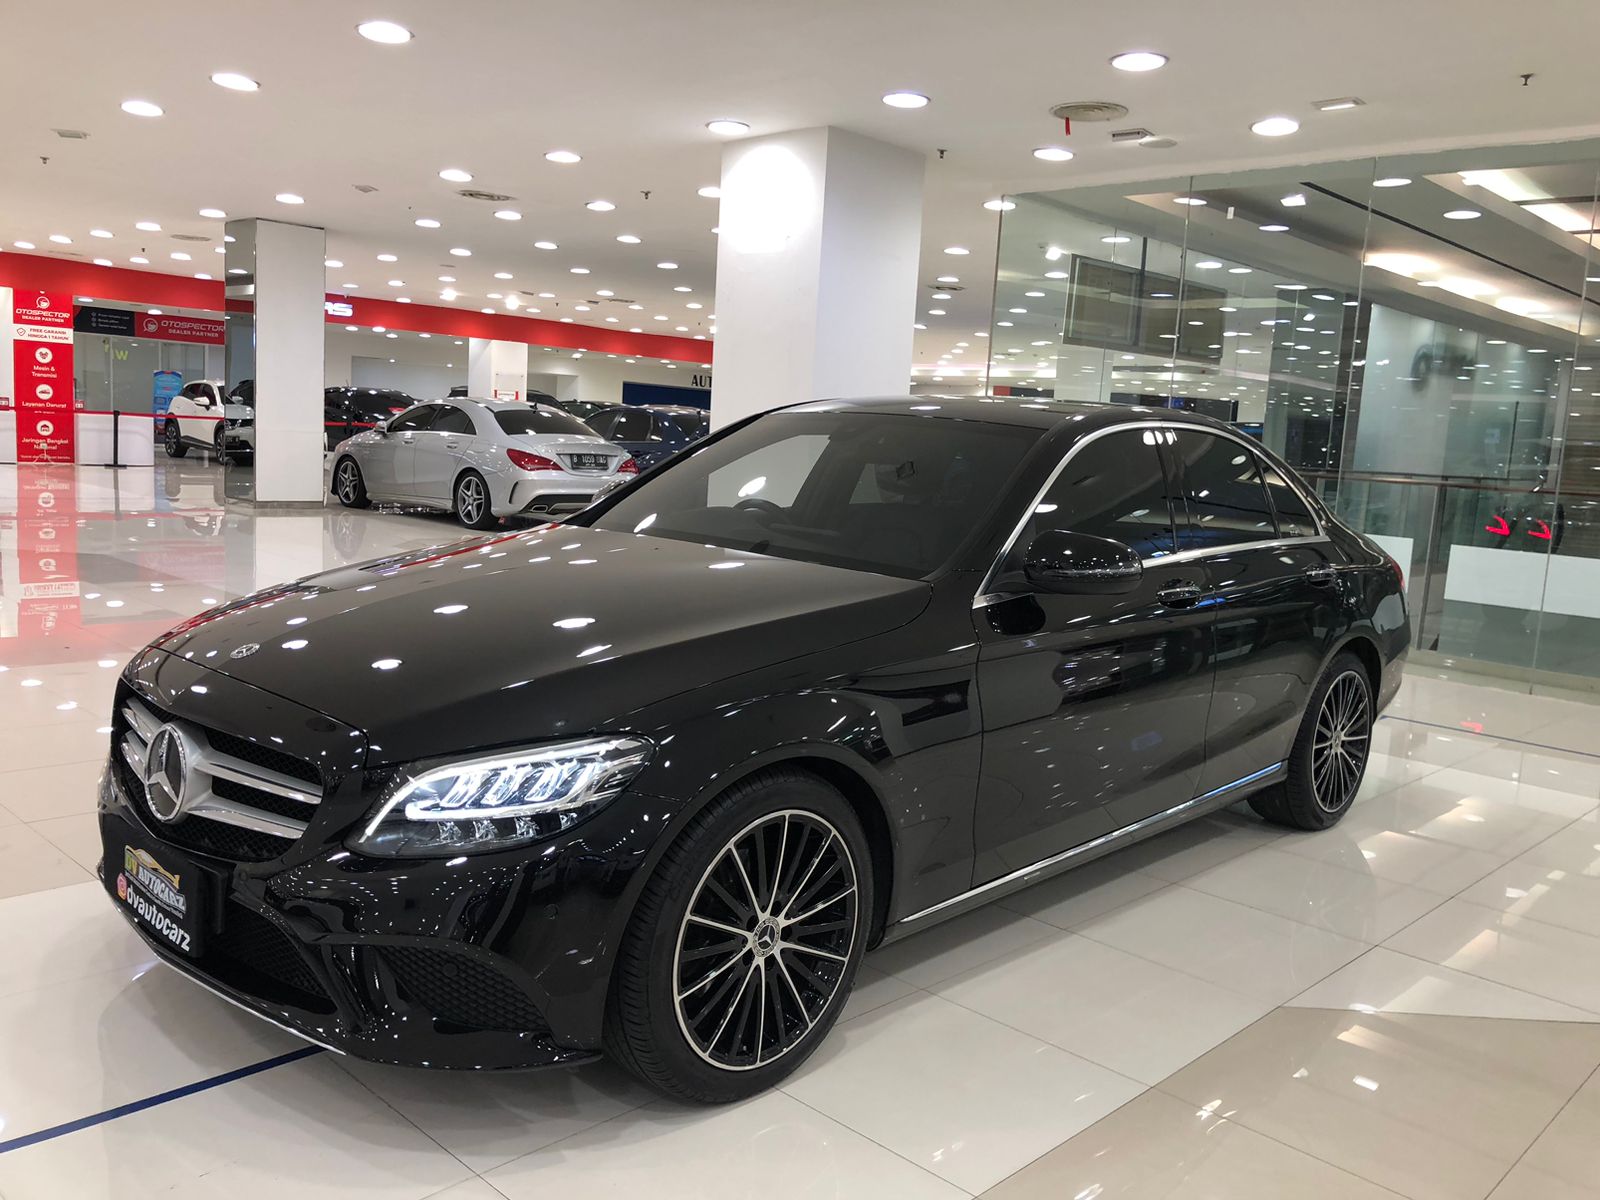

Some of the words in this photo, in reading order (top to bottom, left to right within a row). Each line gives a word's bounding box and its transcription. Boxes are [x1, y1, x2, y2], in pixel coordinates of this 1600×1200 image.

[16, 308, 70, 318] OTOSPECTOR
[161, 320, 224, 331] OTOSPECTOR
[138, 866, 186, 911] AUTOCARZ
[126, 884, 191, 953] dvautocarz
